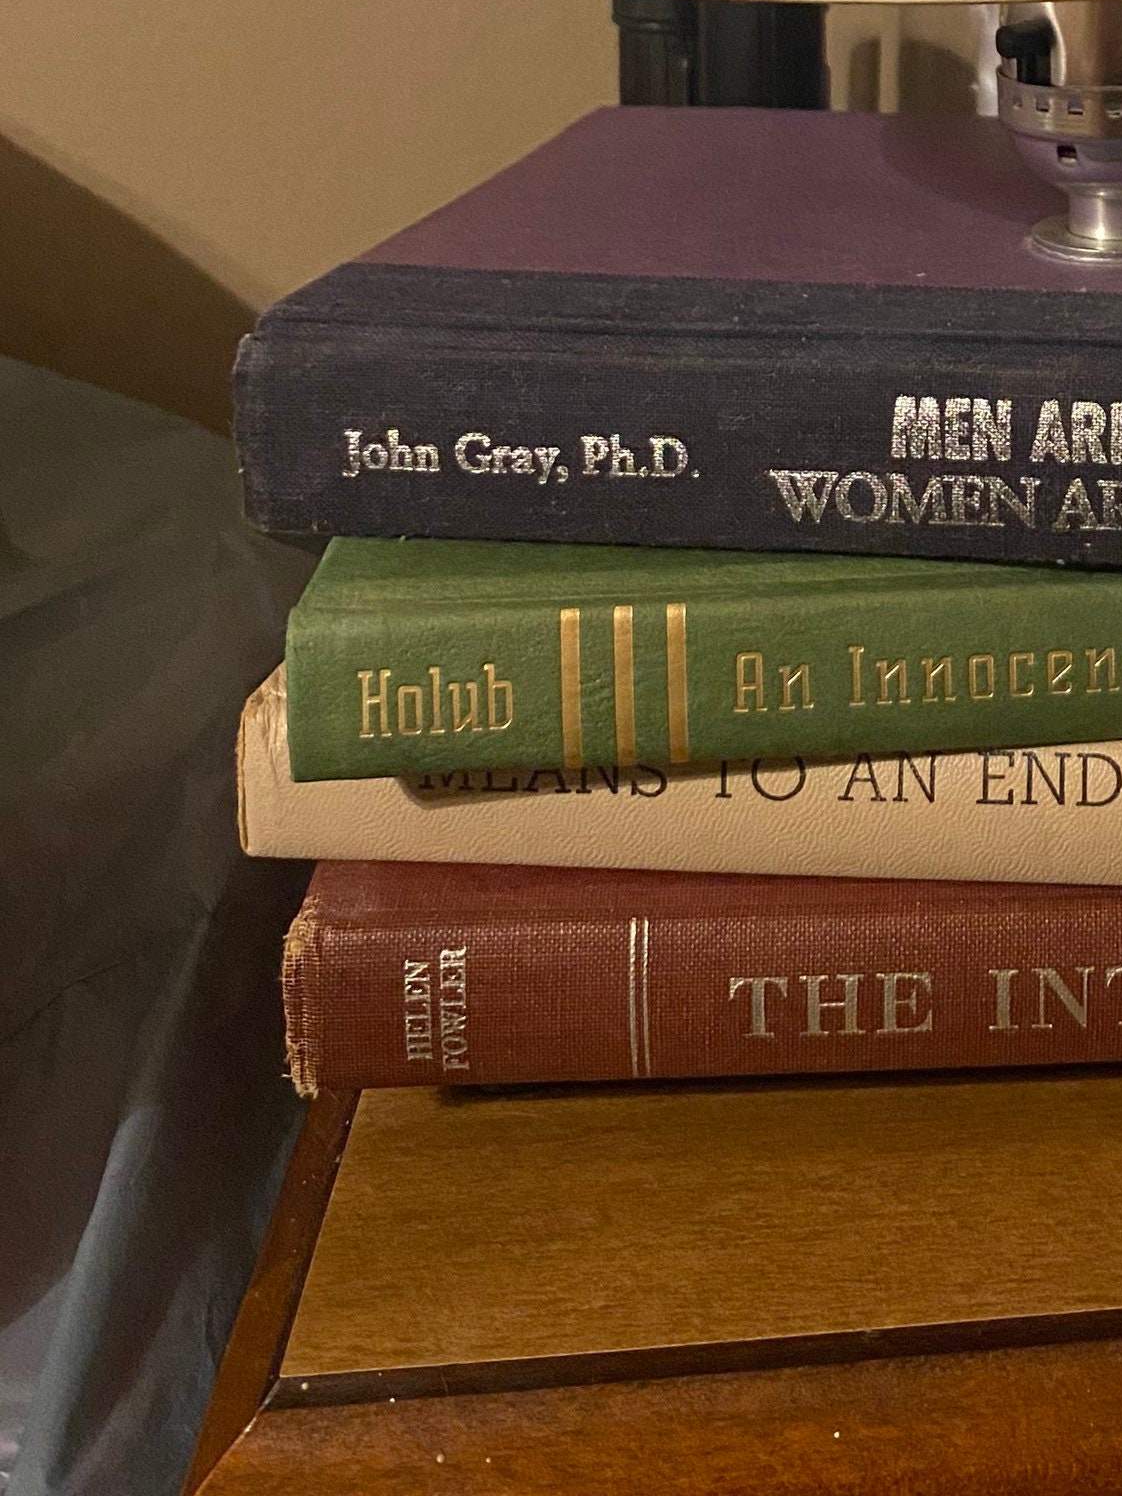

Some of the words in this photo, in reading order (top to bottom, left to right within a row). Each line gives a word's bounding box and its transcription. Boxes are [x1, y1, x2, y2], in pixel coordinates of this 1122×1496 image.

[342, 428, 440, 477] John
[455, 432, 569, 484] Gray,
[581, 433, 699, 479] Ph.D.
[891, 395, 1012, 461] MEN
[768, 468, 1040, 528] WOMEN
[358, 663, 513, 738] Holub
[734, 651, 814, 712] An
[838, 751, 938, 803] AN
[405, 960, 433, 1060] HELEN
[440, 946, 470, 1071] FOWLER
[728, 971, 934, 1039] THE
